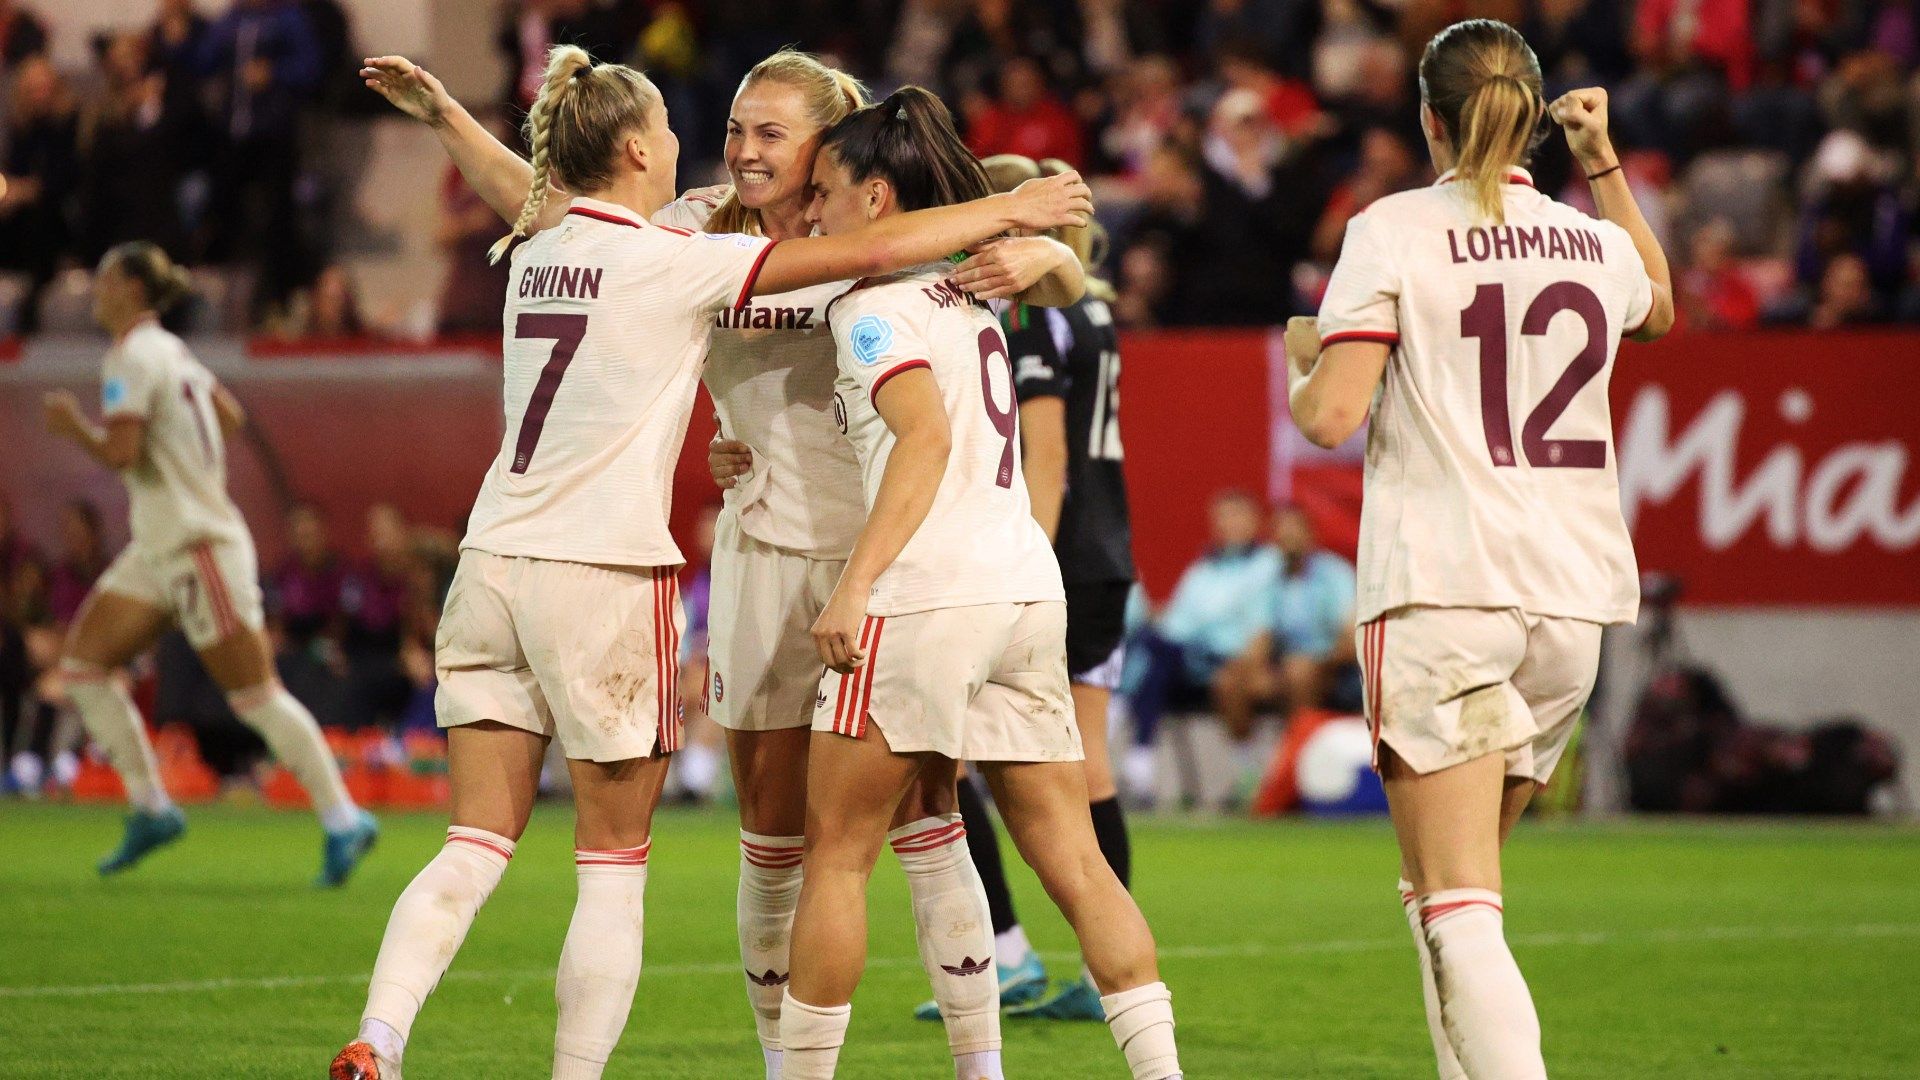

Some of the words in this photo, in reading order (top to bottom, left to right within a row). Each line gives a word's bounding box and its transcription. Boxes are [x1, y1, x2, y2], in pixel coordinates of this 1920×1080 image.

[519, 266, 603, 299] GWINN
[1447, 226, 1604, 264] LOHMANN
[510, 313, 588, 474] 7
[977, 326, 1017, 489] 9
[1461, 281, 1608, 469] 12
[1619, 380, 1920, 553] Mia
